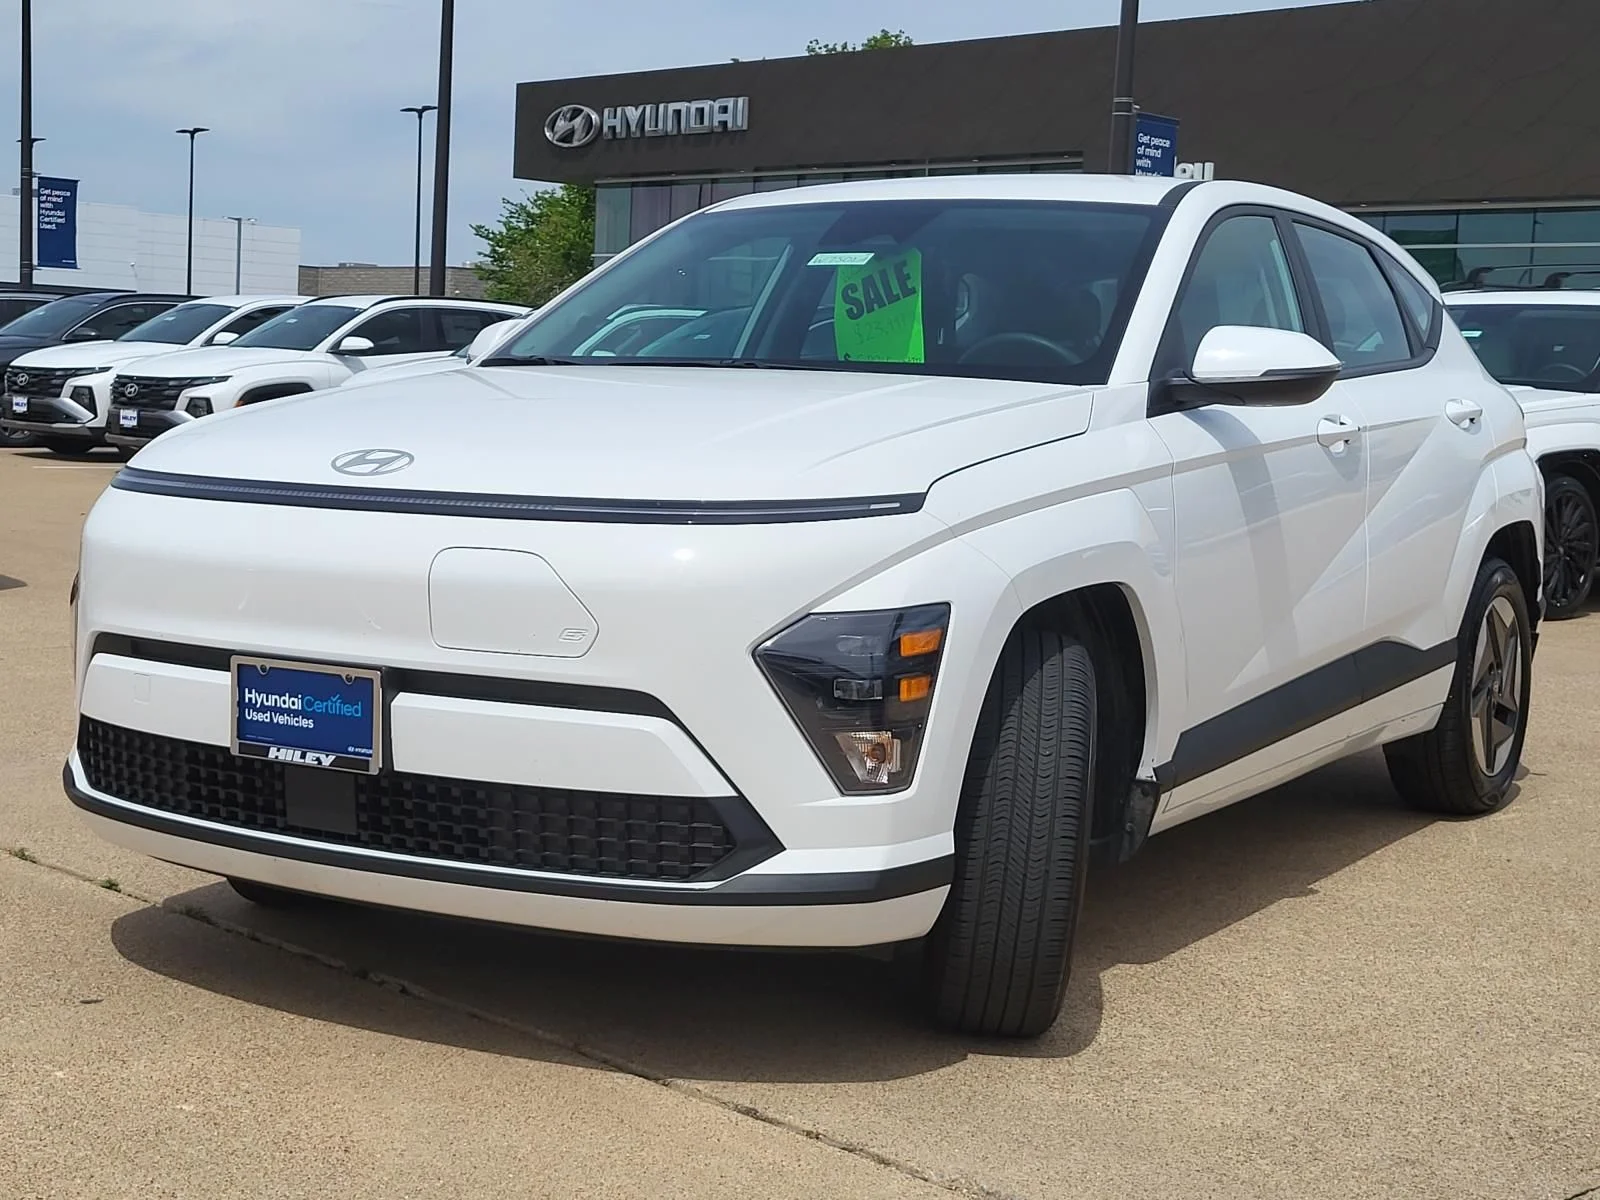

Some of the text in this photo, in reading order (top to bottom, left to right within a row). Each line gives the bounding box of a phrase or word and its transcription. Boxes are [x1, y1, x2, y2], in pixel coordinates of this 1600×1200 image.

[603, 97, 749, 139] HYUNDAI
[1138, 133, 1170, 147] Get peace
[1137, 145, 1161, 157] of mind
[1136, 157, 1151, 168] with
[841, 260, 917, 320] SALE
[244, 688, 362, 717] Hyundai Certified
[245, 708, 314, 728] Used Vehicles
[268, 746, 336, 767] HILEY
